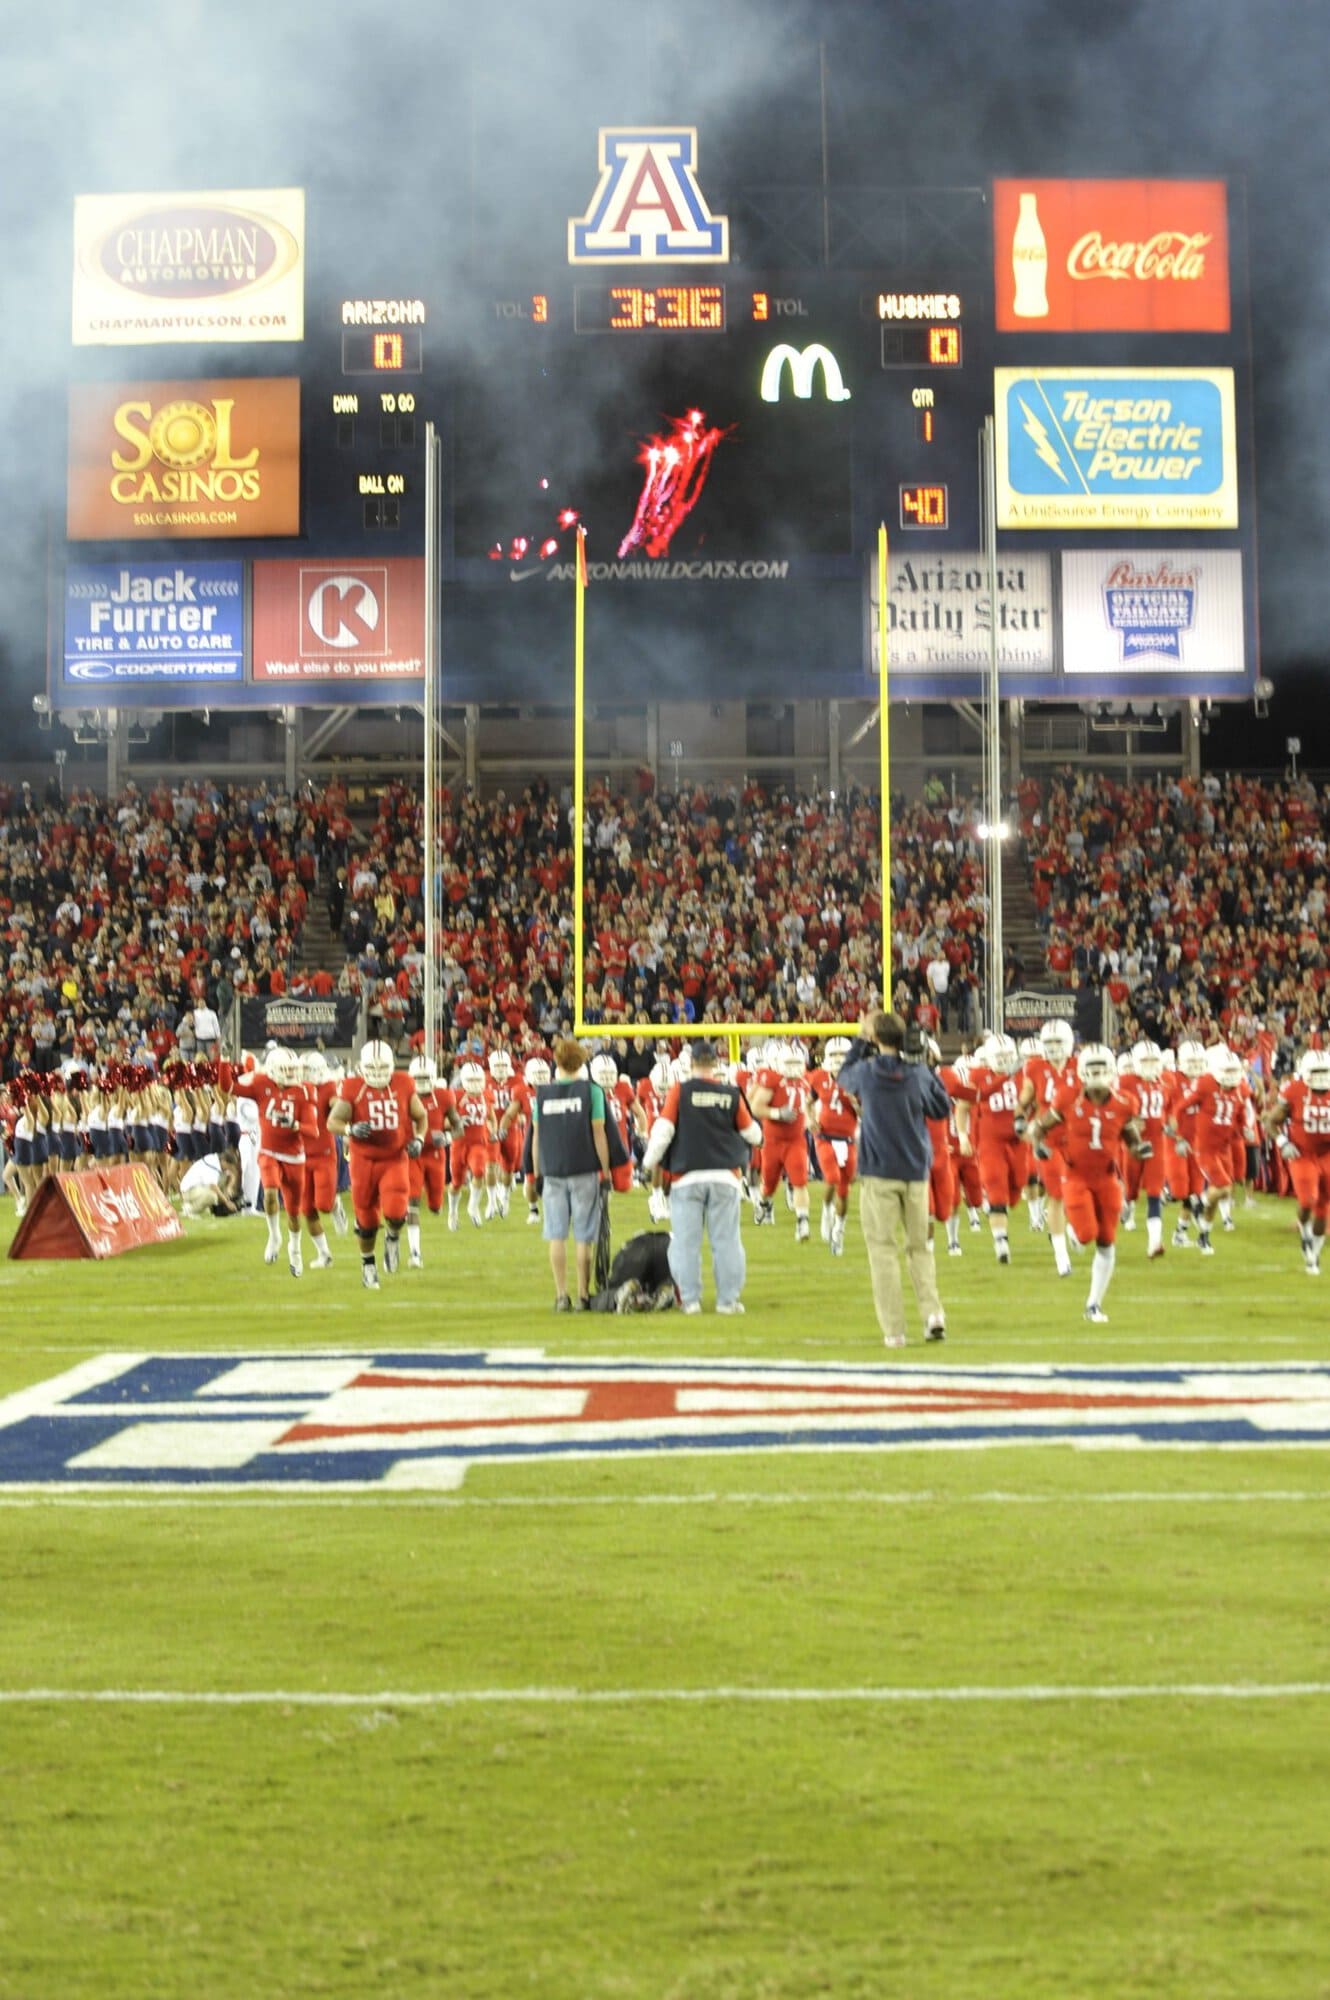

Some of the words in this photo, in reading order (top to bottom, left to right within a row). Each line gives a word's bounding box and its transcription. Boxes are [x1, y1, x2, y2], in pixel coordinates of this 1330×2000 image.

[116, 227, 258, 265] CHAPMAN
[1067, 231, 1211, 279] Coca-Cola
[120, 264, 257, 283] AUTOMOTIVE
[342, 300, 425, 325] ARIZONA
[533, 295, 548, 322] 3
[611, 287, 722, 328] 3:36
[752, 293, 768, 320] 3
[774, 300, 807, 316] TOL
[878, 294, 961, 319] HUSKIES
[90, 315, 287, 330] CHAPMANTUCSON.COM
[373, 333, 403, 369] 0
[929, 327, 960, 364] 0
[332, 395, 358, 413] DWN
[381, 394, 396, 412] TO
[398, 394, 415, 412] GO
[912, 388, 935, 408] QTR
[1062, 391, 1172, 423] Tucson
[111, 399, 260, 472] SOL
[1073, 422, 1202, 451] Electric
[1088, 450, 1202, 481] Power
[110, 469, 260, 504] CASINOS
[359, 474, 386, 494] BALL
[387, 474, 405, 494] ON
[134, 511, 237, 525] SOLCASINOS.COM
[904, 487, 944, 526] 40
[1008, 504, 1019, 517] A
[1102, 504, 1151, 520] Energy
[1156, 503, 1223, 519] Company
[547, 560, 788, 580] ARZONAWILDCATS.COM
[892, 560, 1025, 592] Arizona
[111, 571, 197, 602] Jack
[90, 603, 217, 633] Furrier
[74, 637, 114, 651] TIRE
[118, 637, 131, 650] &
[136, 636, 182, 650] AUTO
[187, 634, 233, 649] CARE
[906, 652, 917, 663] a
[927, 648, 988, 663] Tucson
[265, 660, 299, 674] What
[303, 661, 329, 673] else
[334, 661, 350, 673] do
[354, 663, 377, 676] you
[380, 659, 422, 673] need?
[542, 1097, 583, 1116] ESPN
[691, 1091, 733, 1110] ESPN
[368, 1100, 399, 1131] 55
[1088, 1116, 1103, 1150] 1
